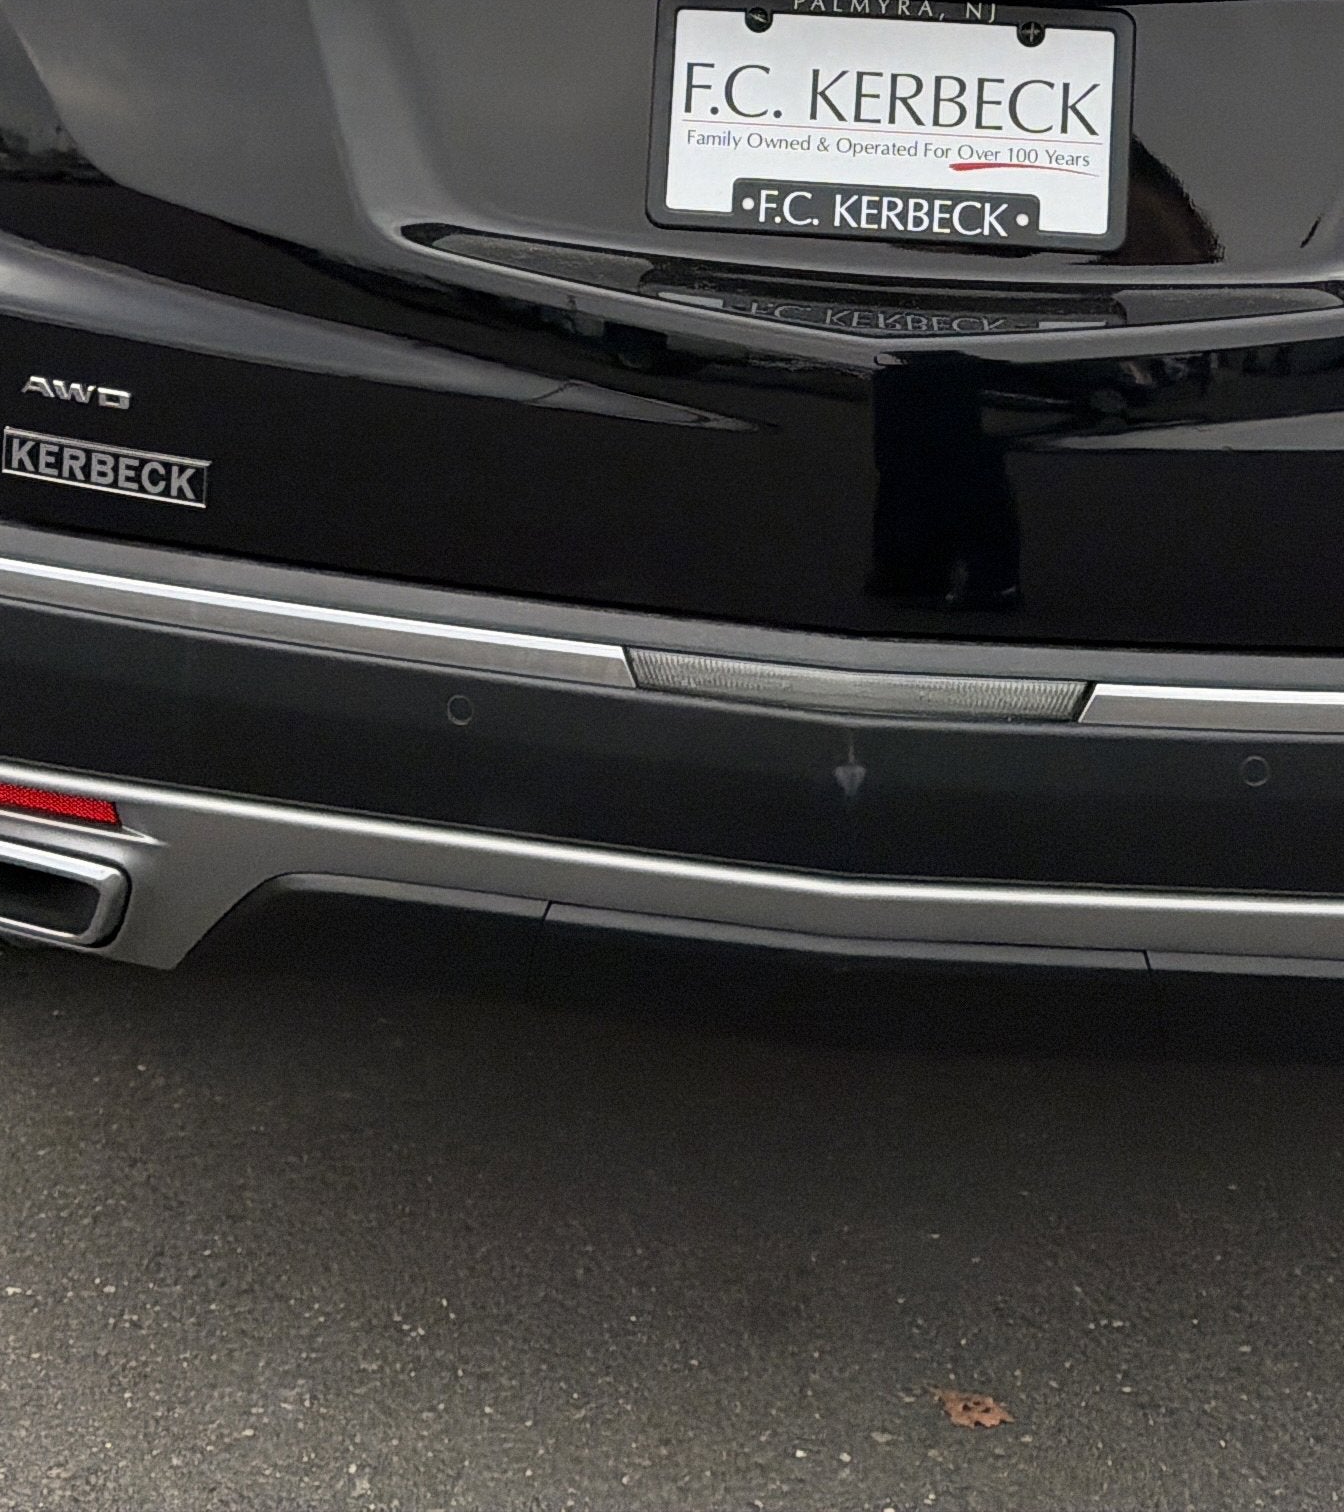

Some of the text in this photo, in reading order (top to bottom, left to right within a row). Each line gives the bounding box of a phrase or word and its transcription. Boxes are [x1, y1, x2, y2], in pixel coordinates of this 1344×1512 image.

[965, 1, 996, 24] NJ
[684, 61, 1101, 137] F.C. KERBECK
[687, 129, 1091, 168] Family Owned & Operated For Over 100 Years
[758, 189, 1009, 237] F.C. KERBECK
[20, 375, 131, 410] AWD
[10, 438, 196, 500] KERBECK
